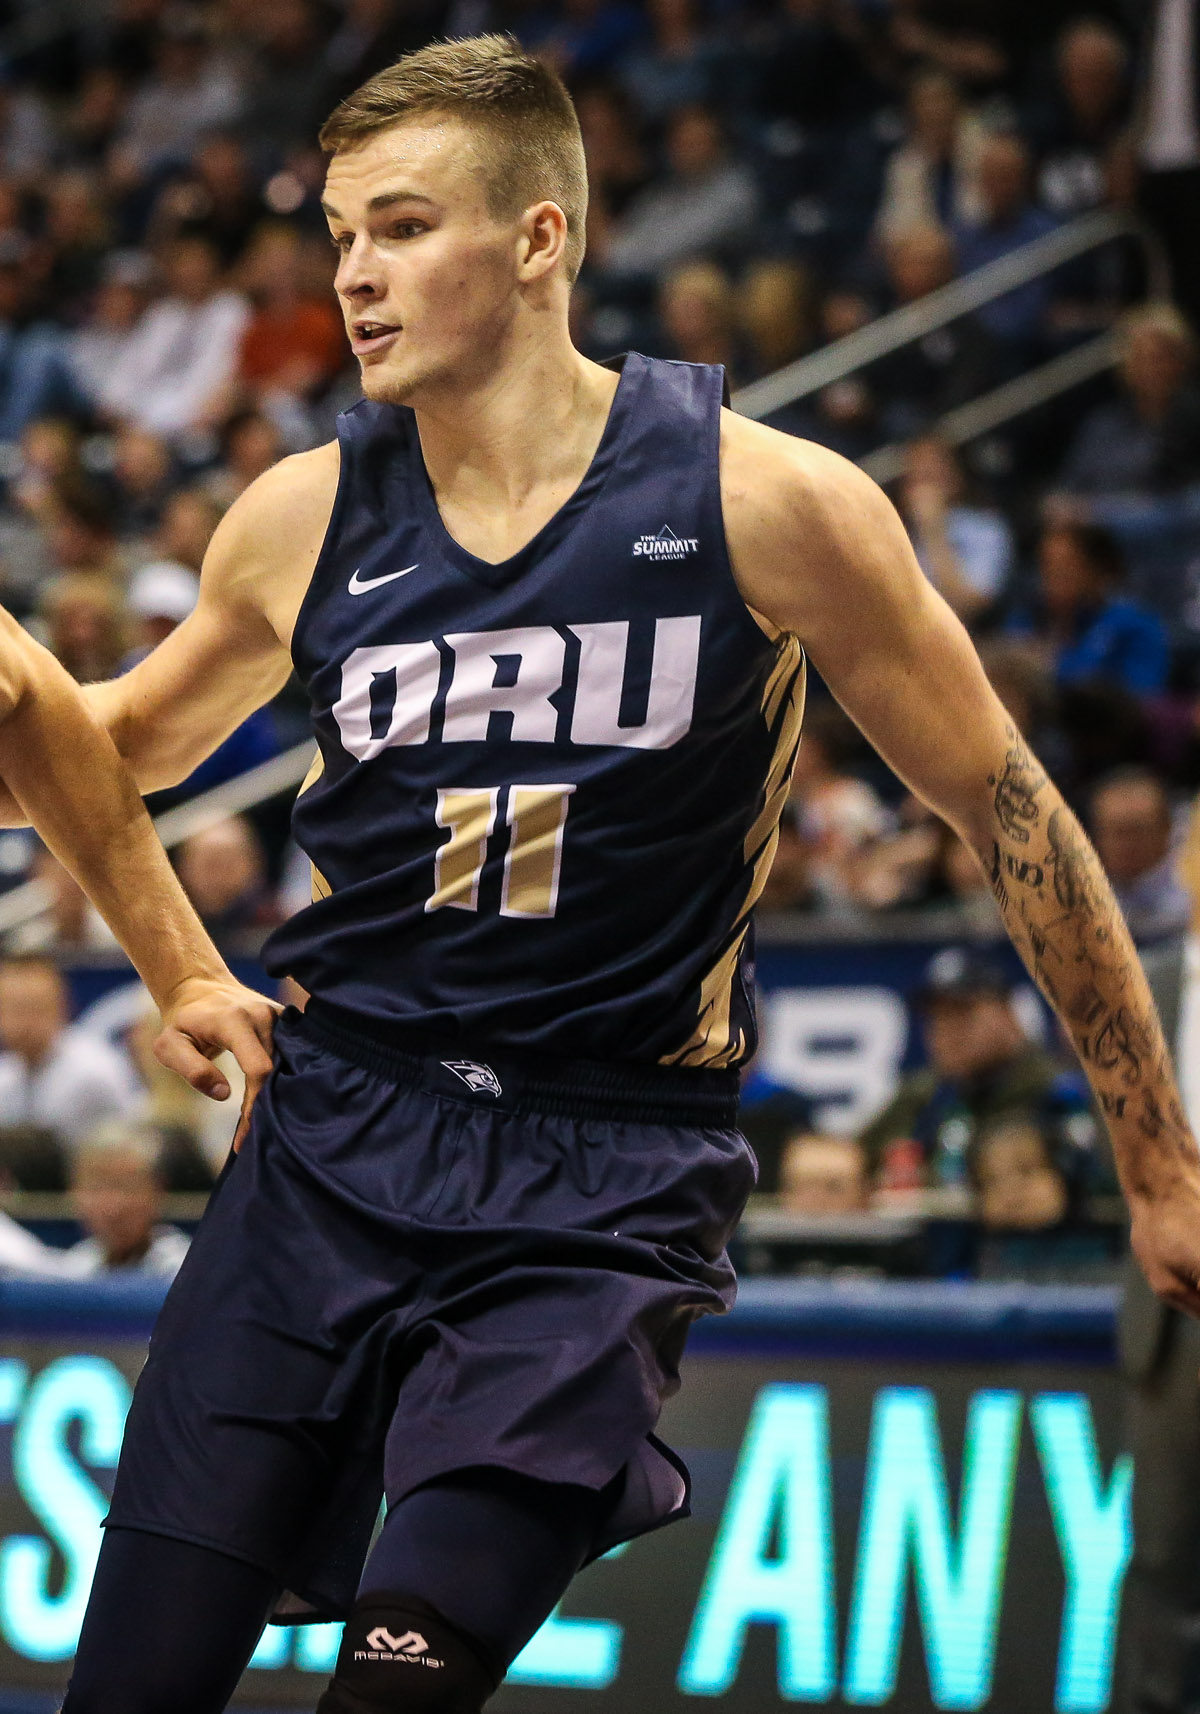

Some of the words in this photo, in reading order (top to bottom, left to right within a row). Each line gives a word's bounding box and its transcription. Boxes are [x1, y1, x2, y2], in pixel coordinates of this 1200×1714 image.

[632, 539, 698, 556] SUMMIT
[332, 615, 701, 763] ORU
[424, 783, 577, 919] 11
